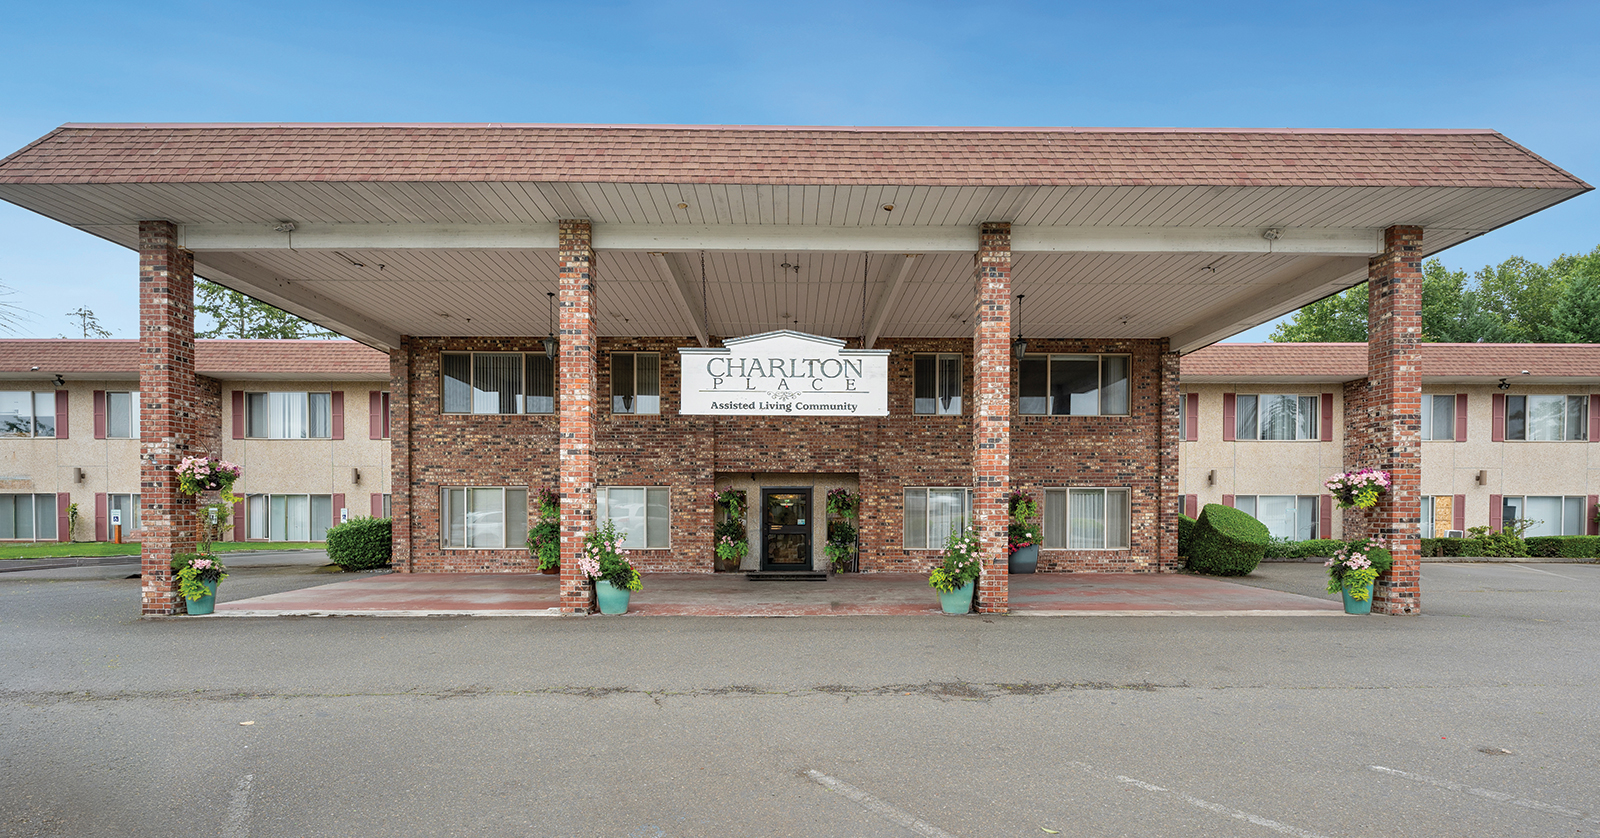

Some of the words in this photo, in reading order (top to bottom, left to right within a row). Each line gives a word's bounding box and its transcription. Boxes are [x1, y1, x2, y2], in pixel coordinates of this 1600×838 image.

[706, 357, 863, 378] CHARLTON
[713, 378, 857, 391] PLACE
[710, 401, 756, 410] Assisted
[759, 401, 792, 412] Living
[796, 402, 858, 413] Community
